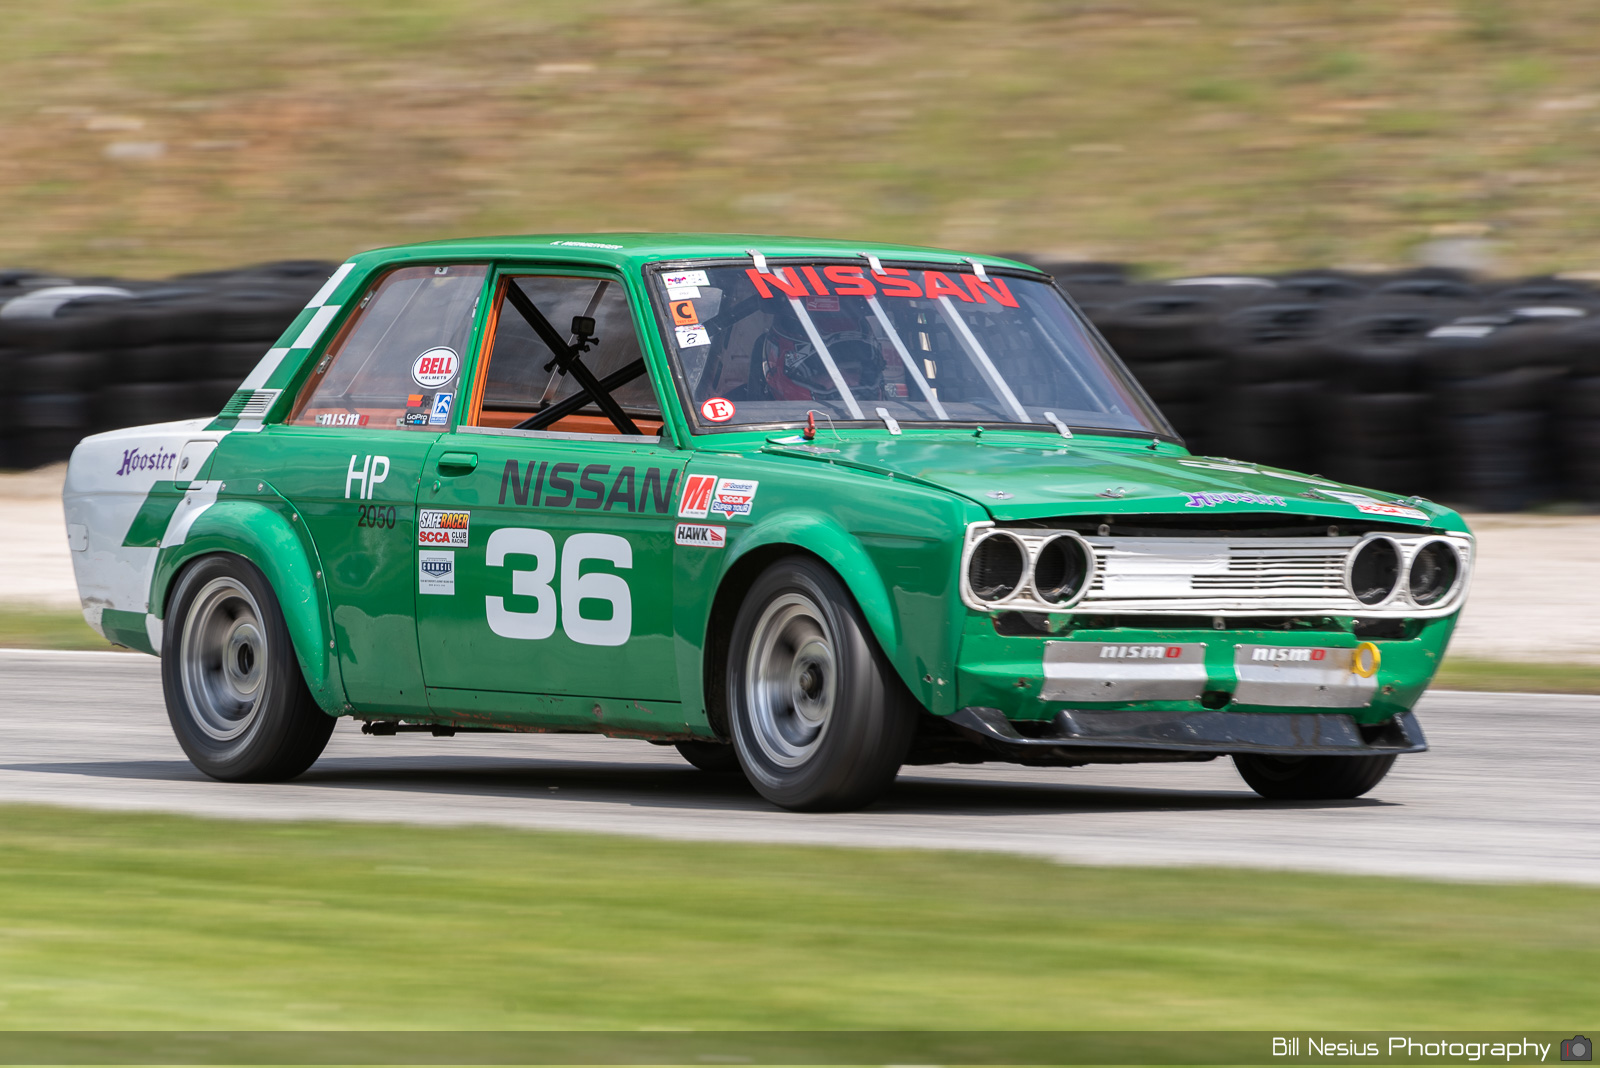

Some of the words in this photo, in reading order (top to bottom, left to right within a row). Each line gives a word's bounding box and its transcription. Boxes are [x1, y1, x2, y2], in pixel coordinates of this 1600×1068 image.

[745, 265, 1020, 308] NISSAN
[676, 302, 692, 319] C
[419, 357, 452, 375] BELL
[406, 413, 428, 421] GoPro
[707, 401, 729, 419] E
[321, 413, 370, 426] nismo
[116, 446, 177, 476] Hoosier
[344, 454, 391, 500] HP
[498, 459, 679, 514] NISSAN
[713, 502, 733, 511] SUPER
[733, 504, 749, 512] TOUR
[722, 496, 744, 504] SCCA
[357, 504, 397, 530] 2050
[420, 511, 469, 530] SAFERACER
[419, 531, 451, 543] SCCA
[451, 531, 467, 539] CLUB
[678, 526, 709, 541] HAWK
[422, 562, 451, 571] COUNCIL
[485, 527, 633, 647] 36
[1099, 645, 1182, 660] nismo
[1251, 647, 1328, 663] nismo
